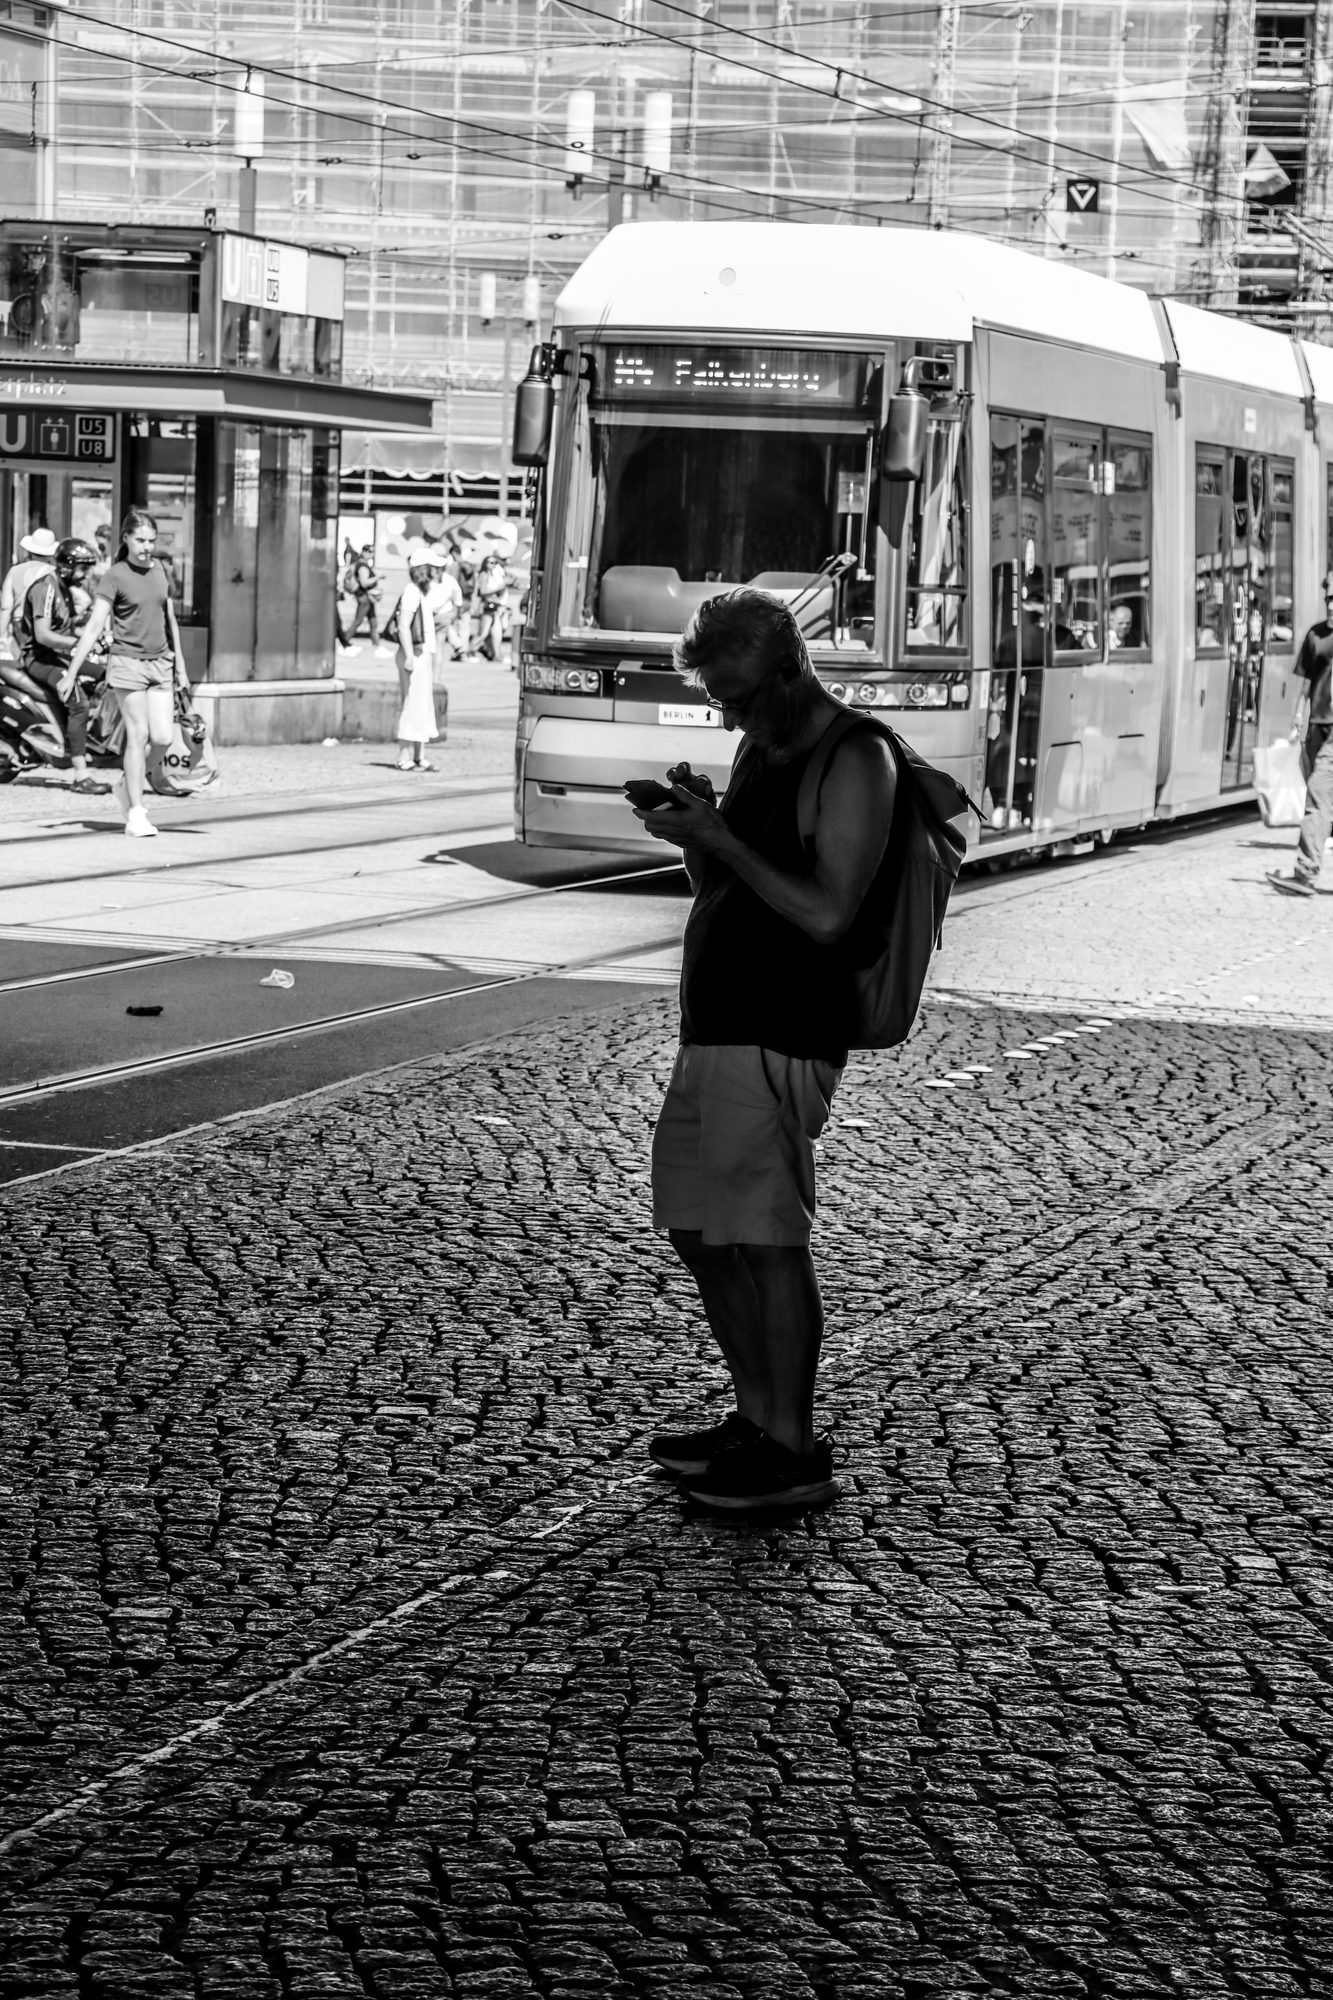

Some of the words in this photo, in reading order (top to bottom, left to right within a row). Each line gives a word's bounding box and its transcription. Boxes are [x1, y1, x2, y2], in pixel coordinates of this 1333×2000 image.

[675, 360, 820, 391] Falkenberg
[81, 419, 103, 434] U5
[81, 440, 103, 455] U8
[663, 710, 695, 719] BERLIN
